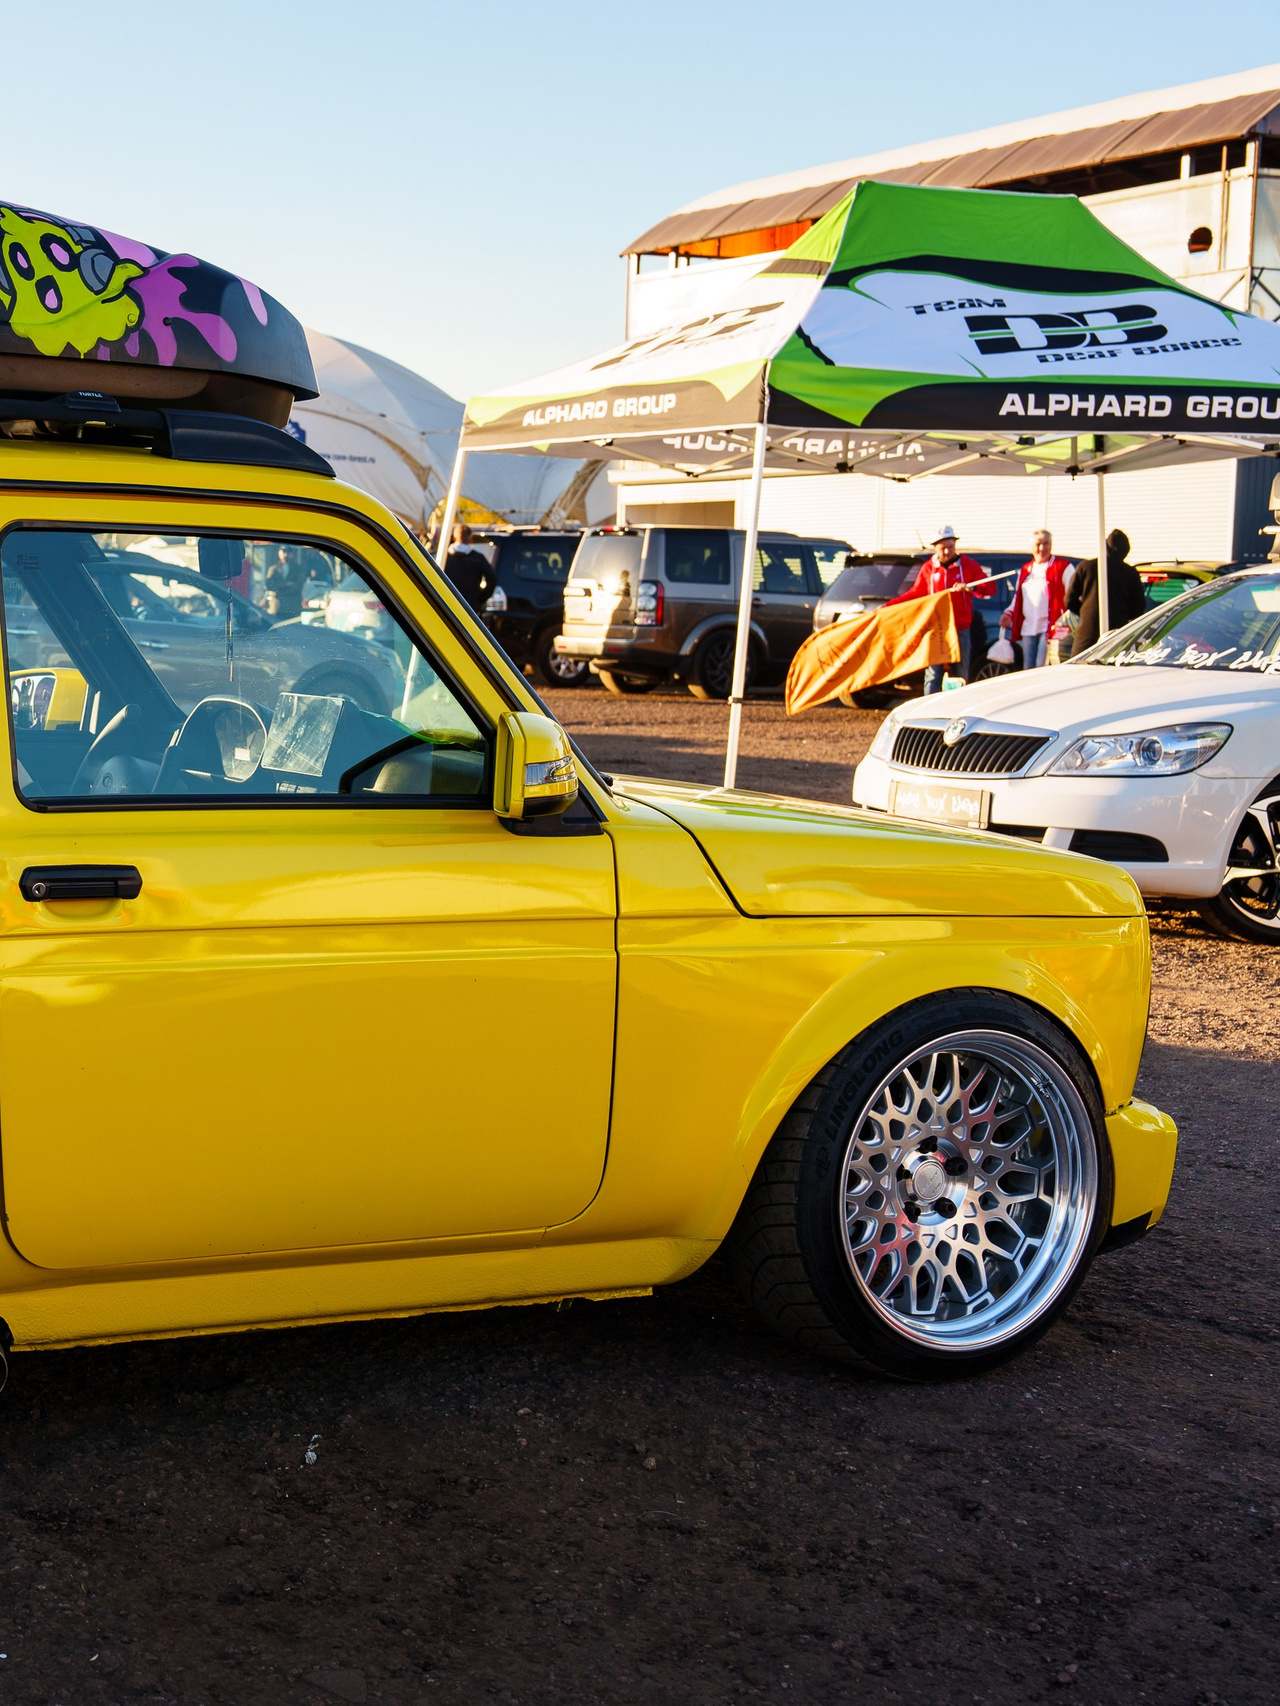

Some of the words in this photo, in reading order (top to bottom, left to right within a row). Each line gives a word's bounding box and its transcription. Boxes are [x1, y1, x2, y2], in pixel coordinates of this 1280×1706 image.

[522, 400, 609, 427] ALPHARD
[612, 393, 677, 418] GROUP
[999, 393, 1172, 417] ALPHARD
[1186, 395, 1280, 419] GROU
[823, 1029, 905, 1142] LINGLONG
